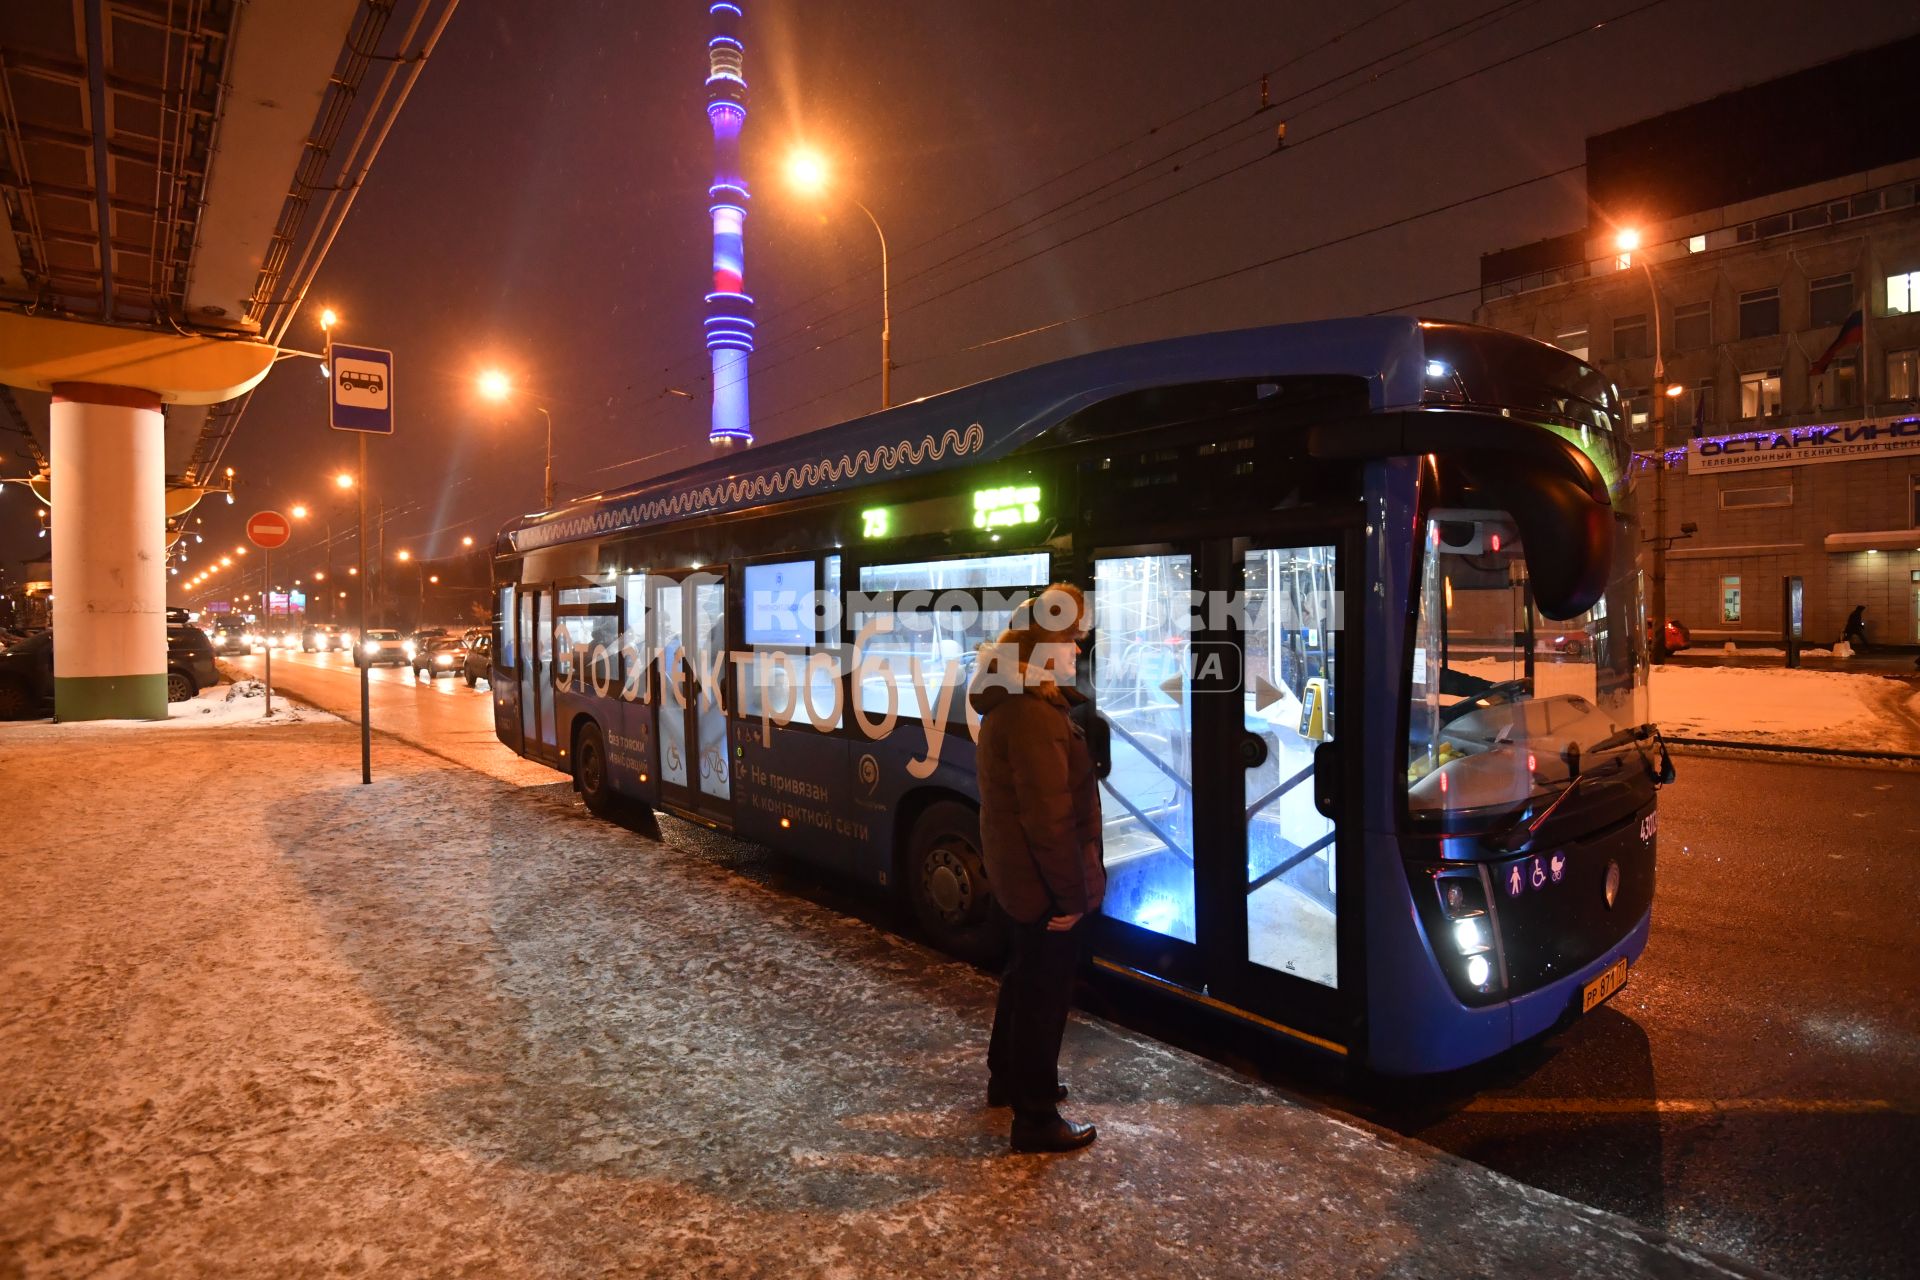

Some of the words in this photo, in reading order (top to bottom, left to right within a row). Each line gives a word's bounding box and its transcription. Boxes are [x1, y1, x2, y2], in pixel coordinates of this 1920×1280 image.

[1701, 420, 1920, 456] ОСТАНКИНО
[1702, 452, 1792, 467] ТЕЛЕВИЗИОННЫЙ
[1797, 443, 1878, 458] ТЕХНИЧЕСКИЙ
[554, 624, 610, 698] Это
[751, 765, 767, 787] Не
[769, 773, 829, 803] привязан
[761, 796, 833, 831] контактной
[1600, 969, 1615, 998] 871
